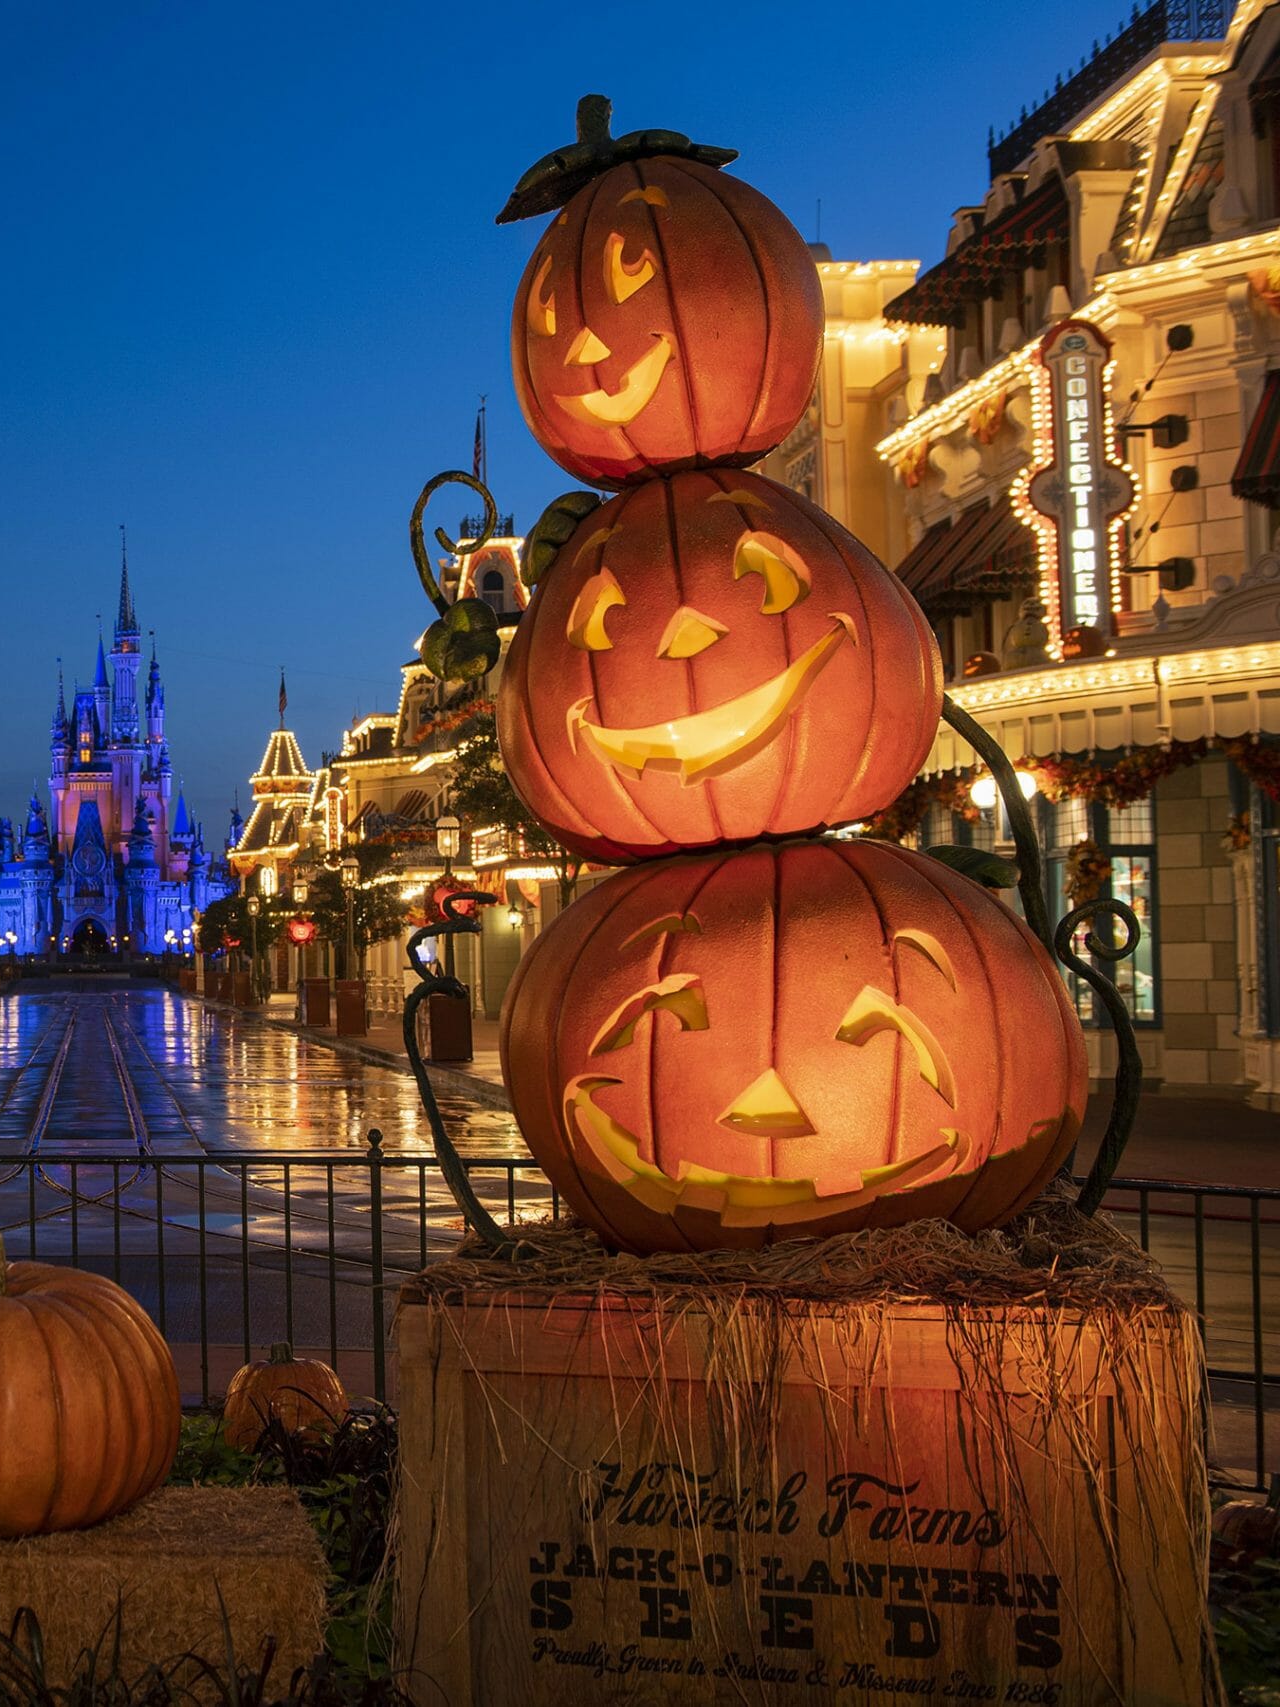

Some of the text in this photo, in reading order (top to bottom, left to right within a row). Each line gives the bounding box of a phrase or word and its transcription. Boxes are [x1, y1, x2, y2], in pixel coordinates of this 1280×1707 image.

[818, 1472, 1007, 1547] Farms
[530, 1542, 1062, 1610] JACK-O-LANTERN
[530, 1579, 1064, 1670] SEEDS
[532, 1636, 1064, 1706] Proudly Grown in Indiana & Missouri Since 1886
